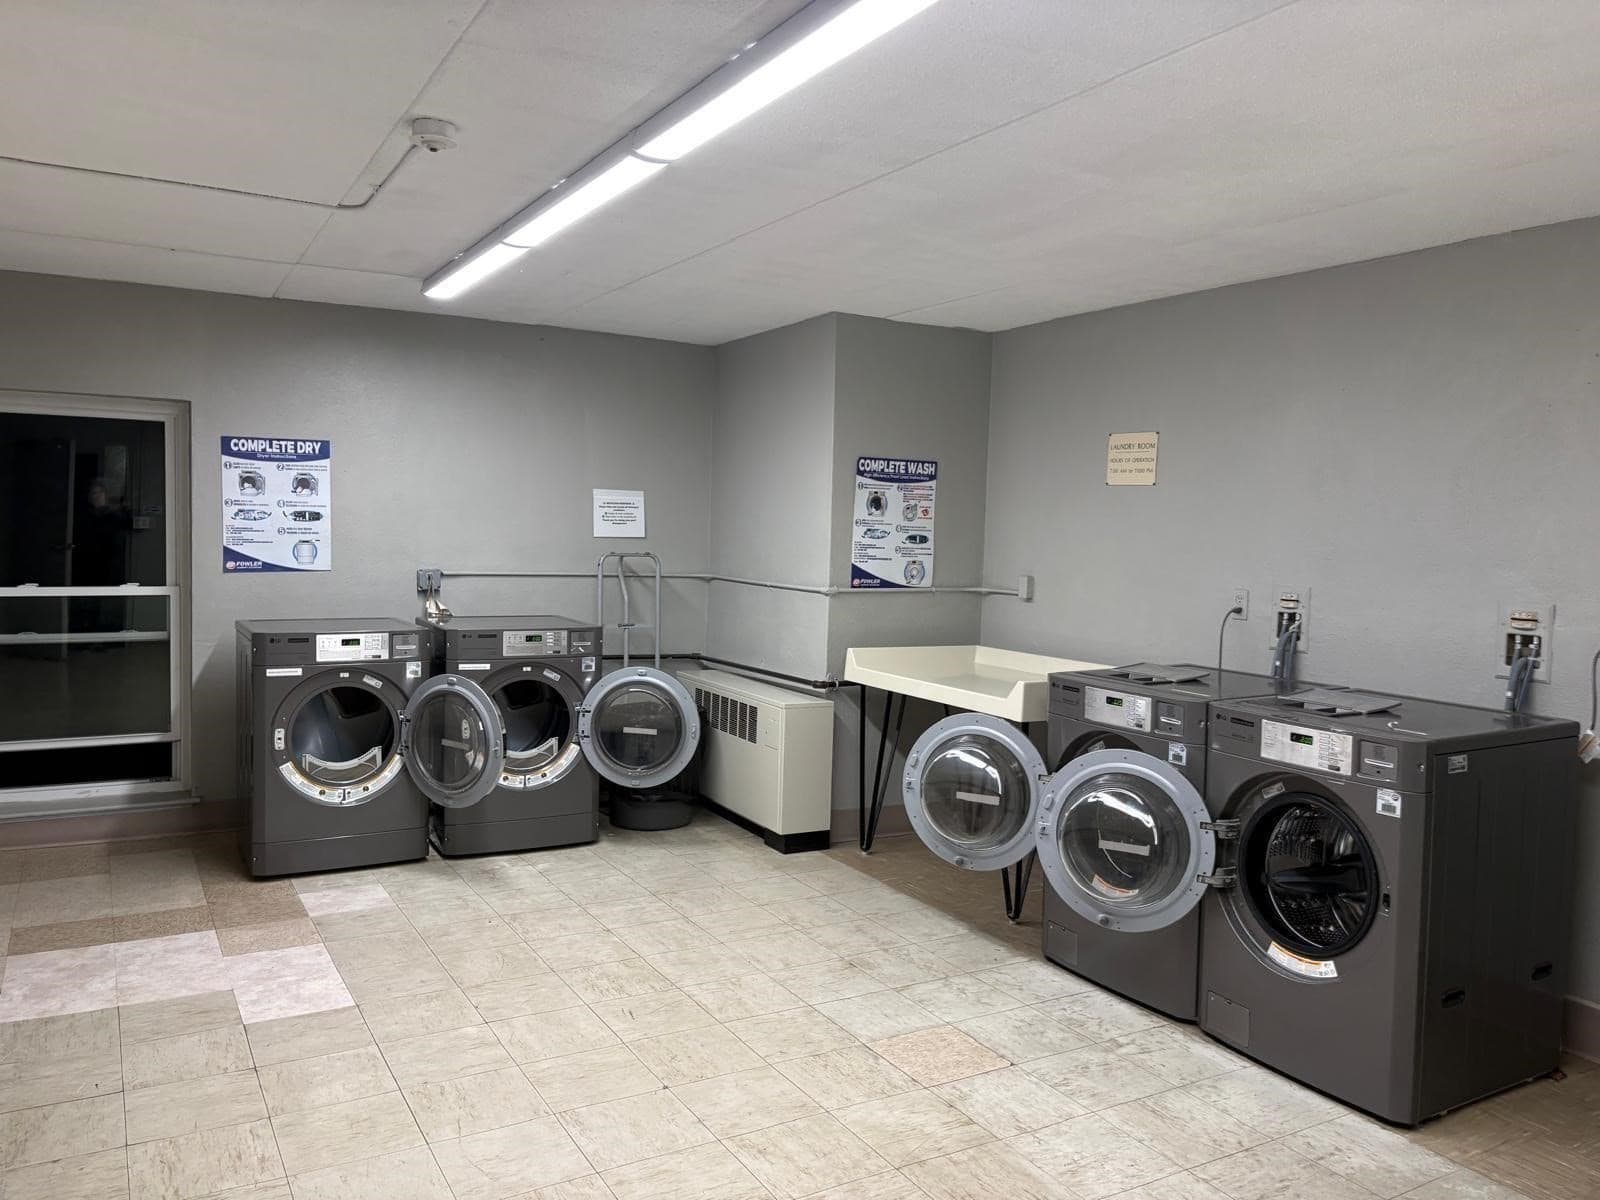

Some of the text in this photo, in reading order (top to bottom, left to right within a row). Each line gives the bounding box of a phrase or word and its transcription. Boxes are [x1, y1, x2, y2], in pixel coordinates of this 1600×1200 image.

[230, 439, 322, 455] COMPLETE DRY
[1110, 442, 1156, 451] LAUNDRY ROOM
[858, 459, 936, 476] COMPLETE WASH
